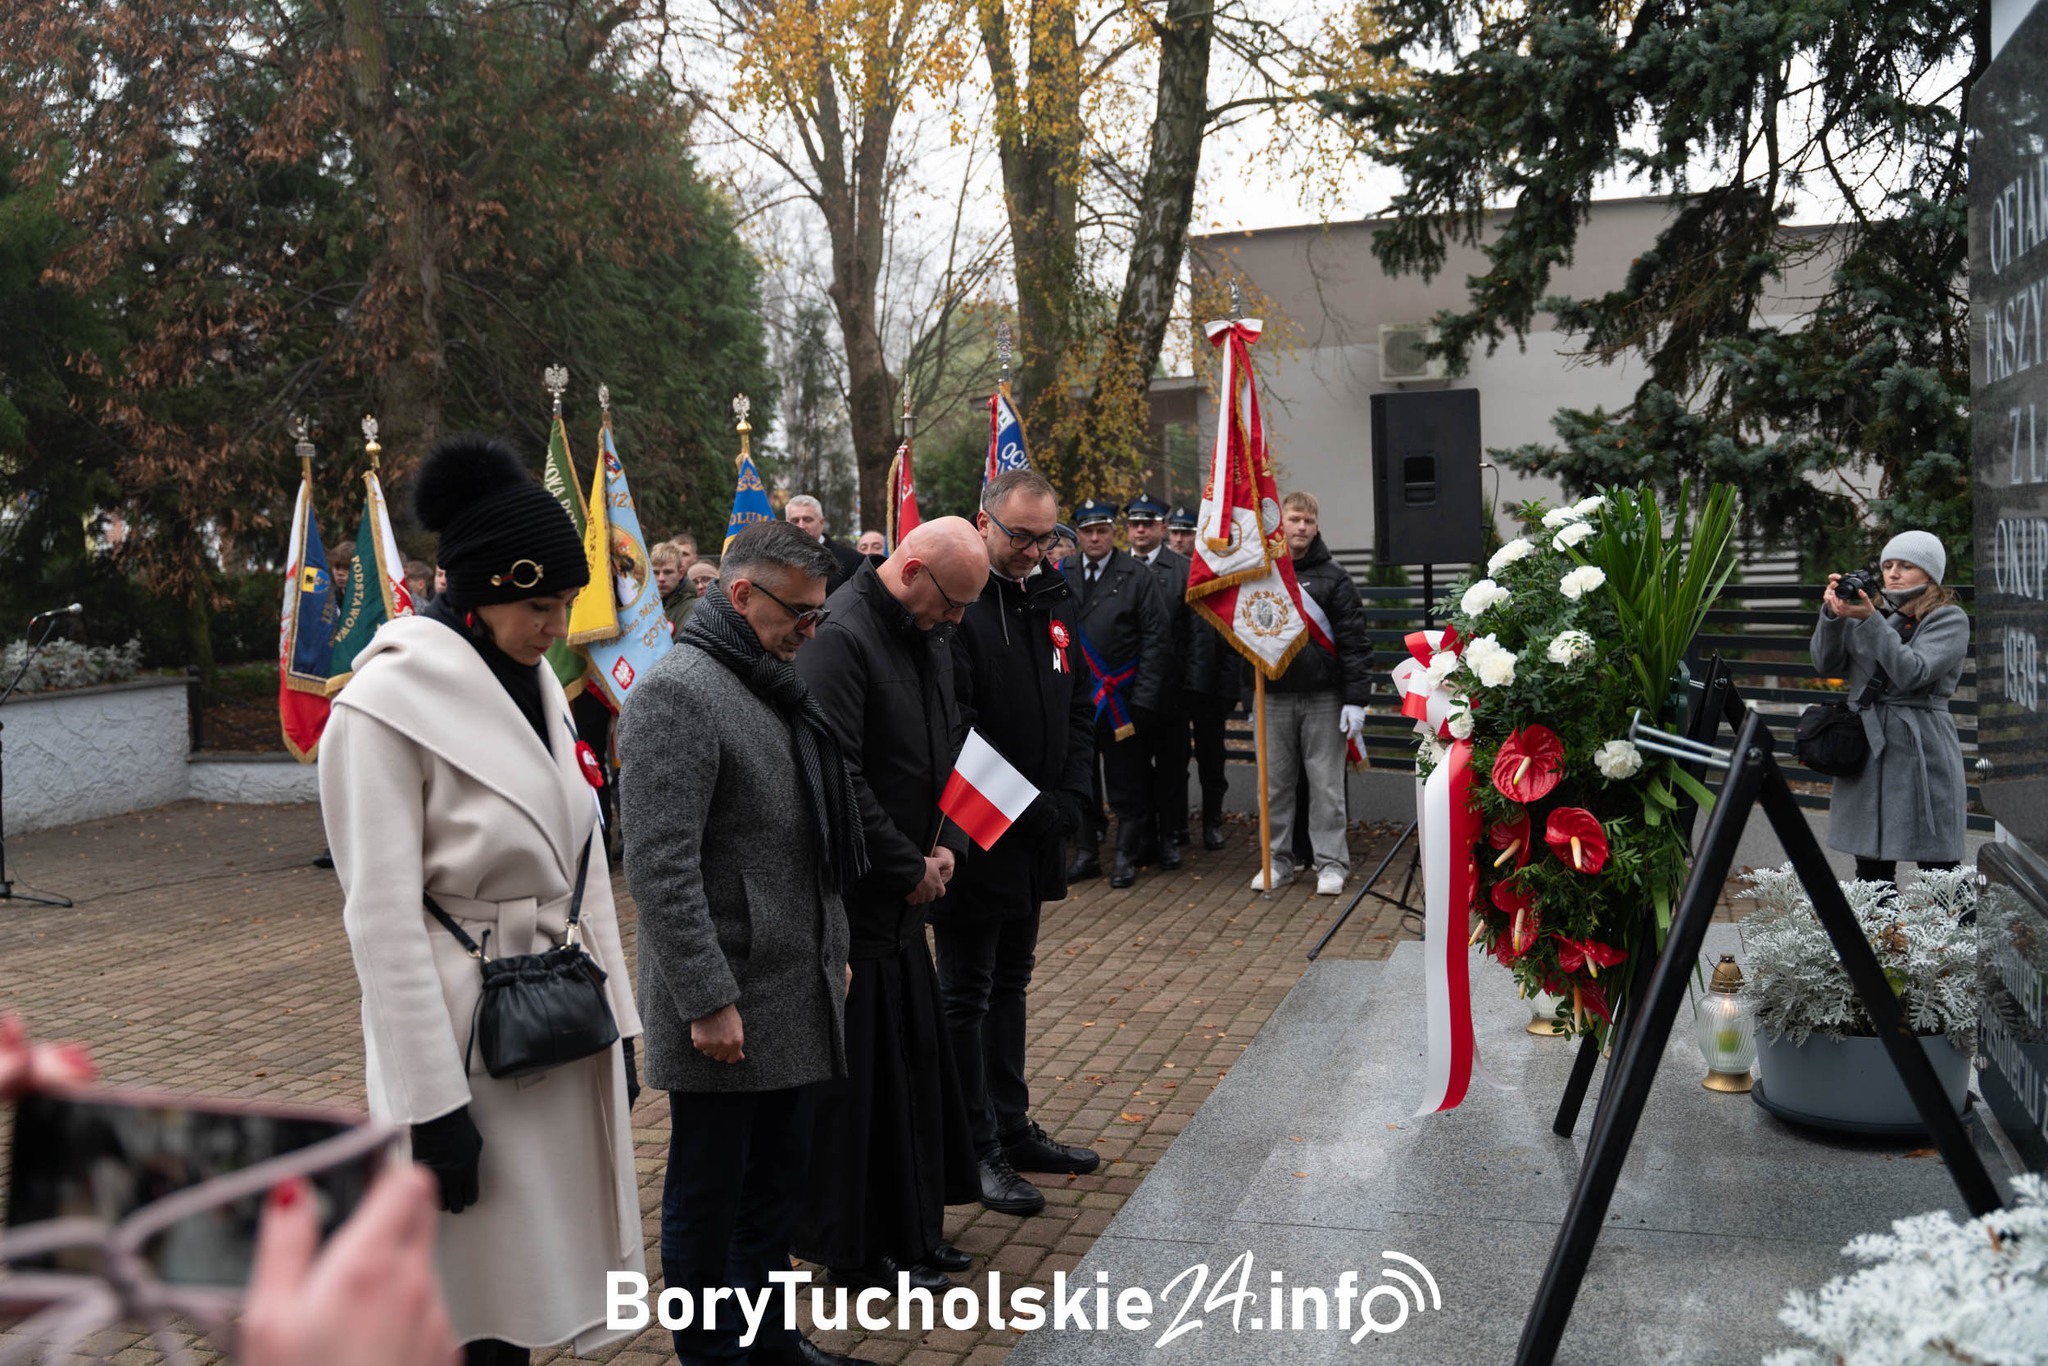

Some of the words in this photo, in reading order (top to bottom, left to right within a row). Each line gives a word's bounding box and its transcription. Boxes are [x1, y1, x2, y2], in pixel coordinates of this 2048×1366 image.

[1985, 276, 2048, 385] FASZY
[1994, 518, 2048, 601] OKUP
[2002, 623, 2048, 713] 1939-
